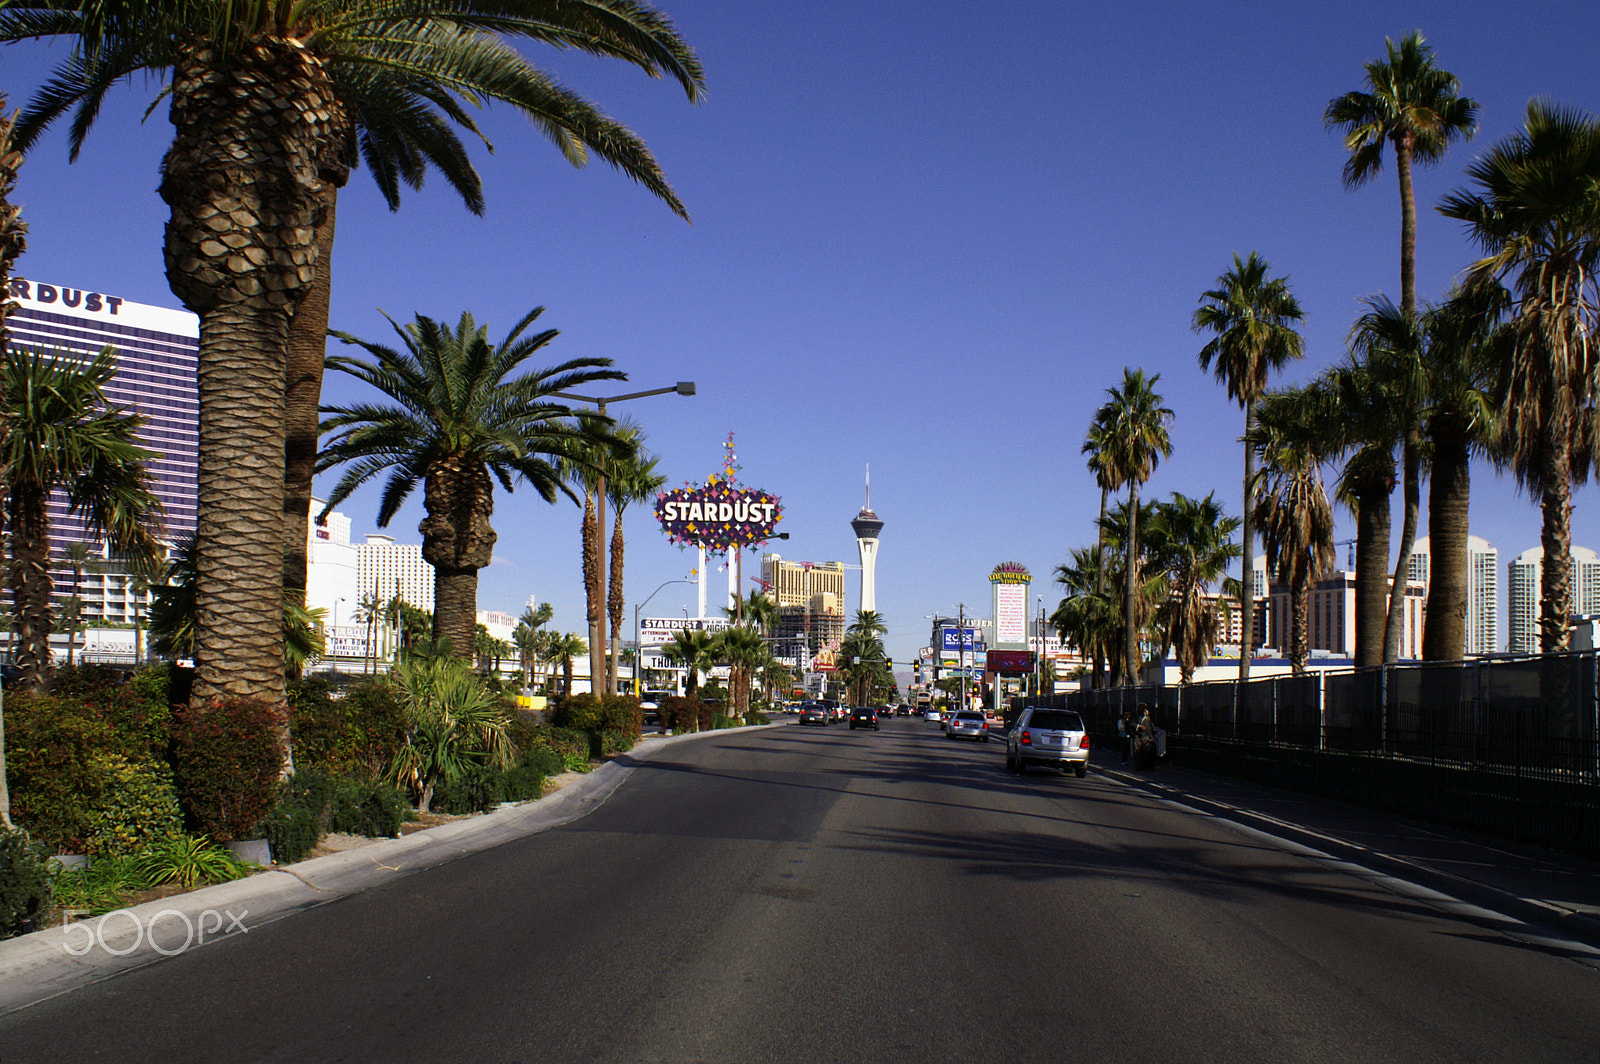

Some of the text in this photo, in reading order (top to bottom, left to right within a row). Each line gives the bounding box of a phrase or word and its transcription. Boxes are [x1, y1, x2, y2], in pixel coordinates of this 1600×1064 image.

[664, 501, 775, 522] STARDUST
[645, 619, 698, 629] STARDUST
[89, 641, 135, 652] CASINO
